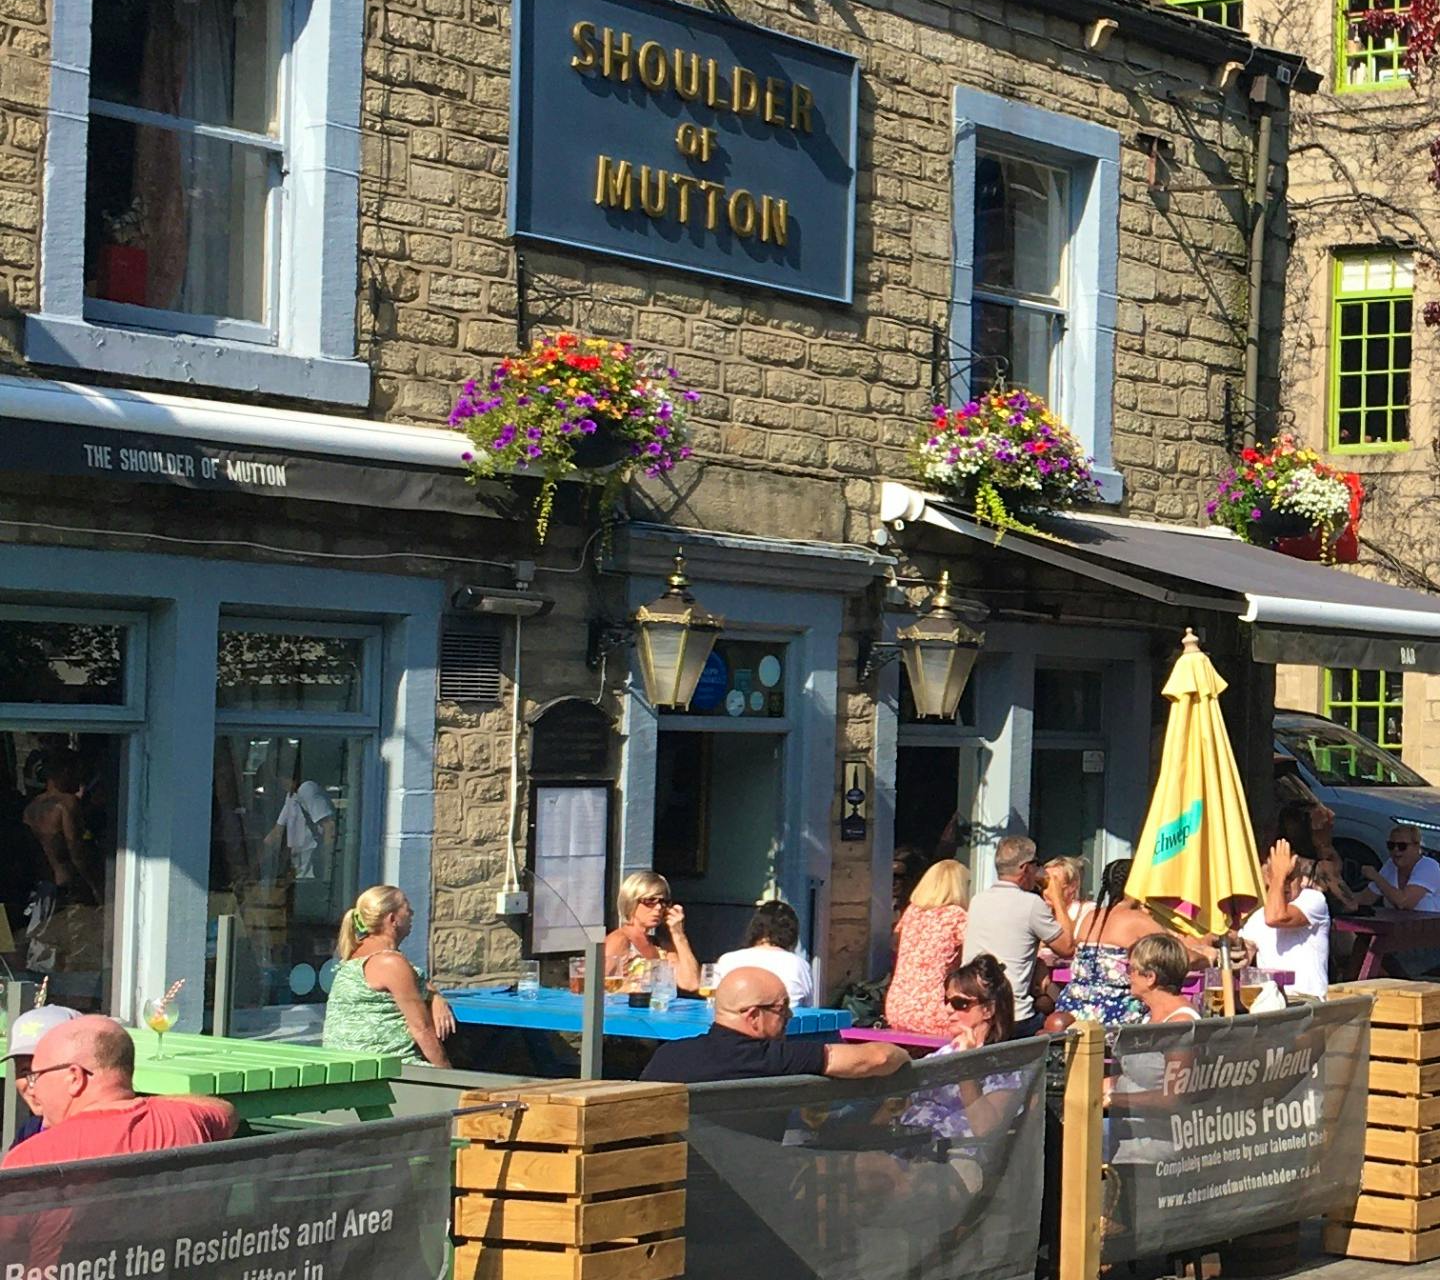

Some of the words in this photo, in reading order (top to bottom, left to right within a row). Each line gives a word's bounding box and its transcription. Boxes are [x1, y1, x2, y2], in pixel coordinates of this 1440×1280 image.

[570, 20, 816, 133] SHOULDER
[675, 122, 717, 162] OF
[595, 154, 789, 246] MUTTON
[83, 444, 113, 469] THE
[120, 448, 195, 477] SHOULDER
[201, 457, 220, 480] OF
[226, 459, 287, 487] MUTTON
[1400, 647, 1416, 665] BAR
[1163, 1055, 1260, 1096] Fabulous
[1170, 1105, 1257, 1152] Delicious
[1263, 1090, 1317, 1134] Food
[1242, 1143, 1252, 1161] by
[1254, 1142, 1268, 1157] our
[1270, 1132, 1307, 1153] talented
[125, 1245, 166, 1277] the
[175, 1223, 290, 1269] Residents
[297, 1211, 337, 1247] and
[342, 1208, 394, 1239] Area
